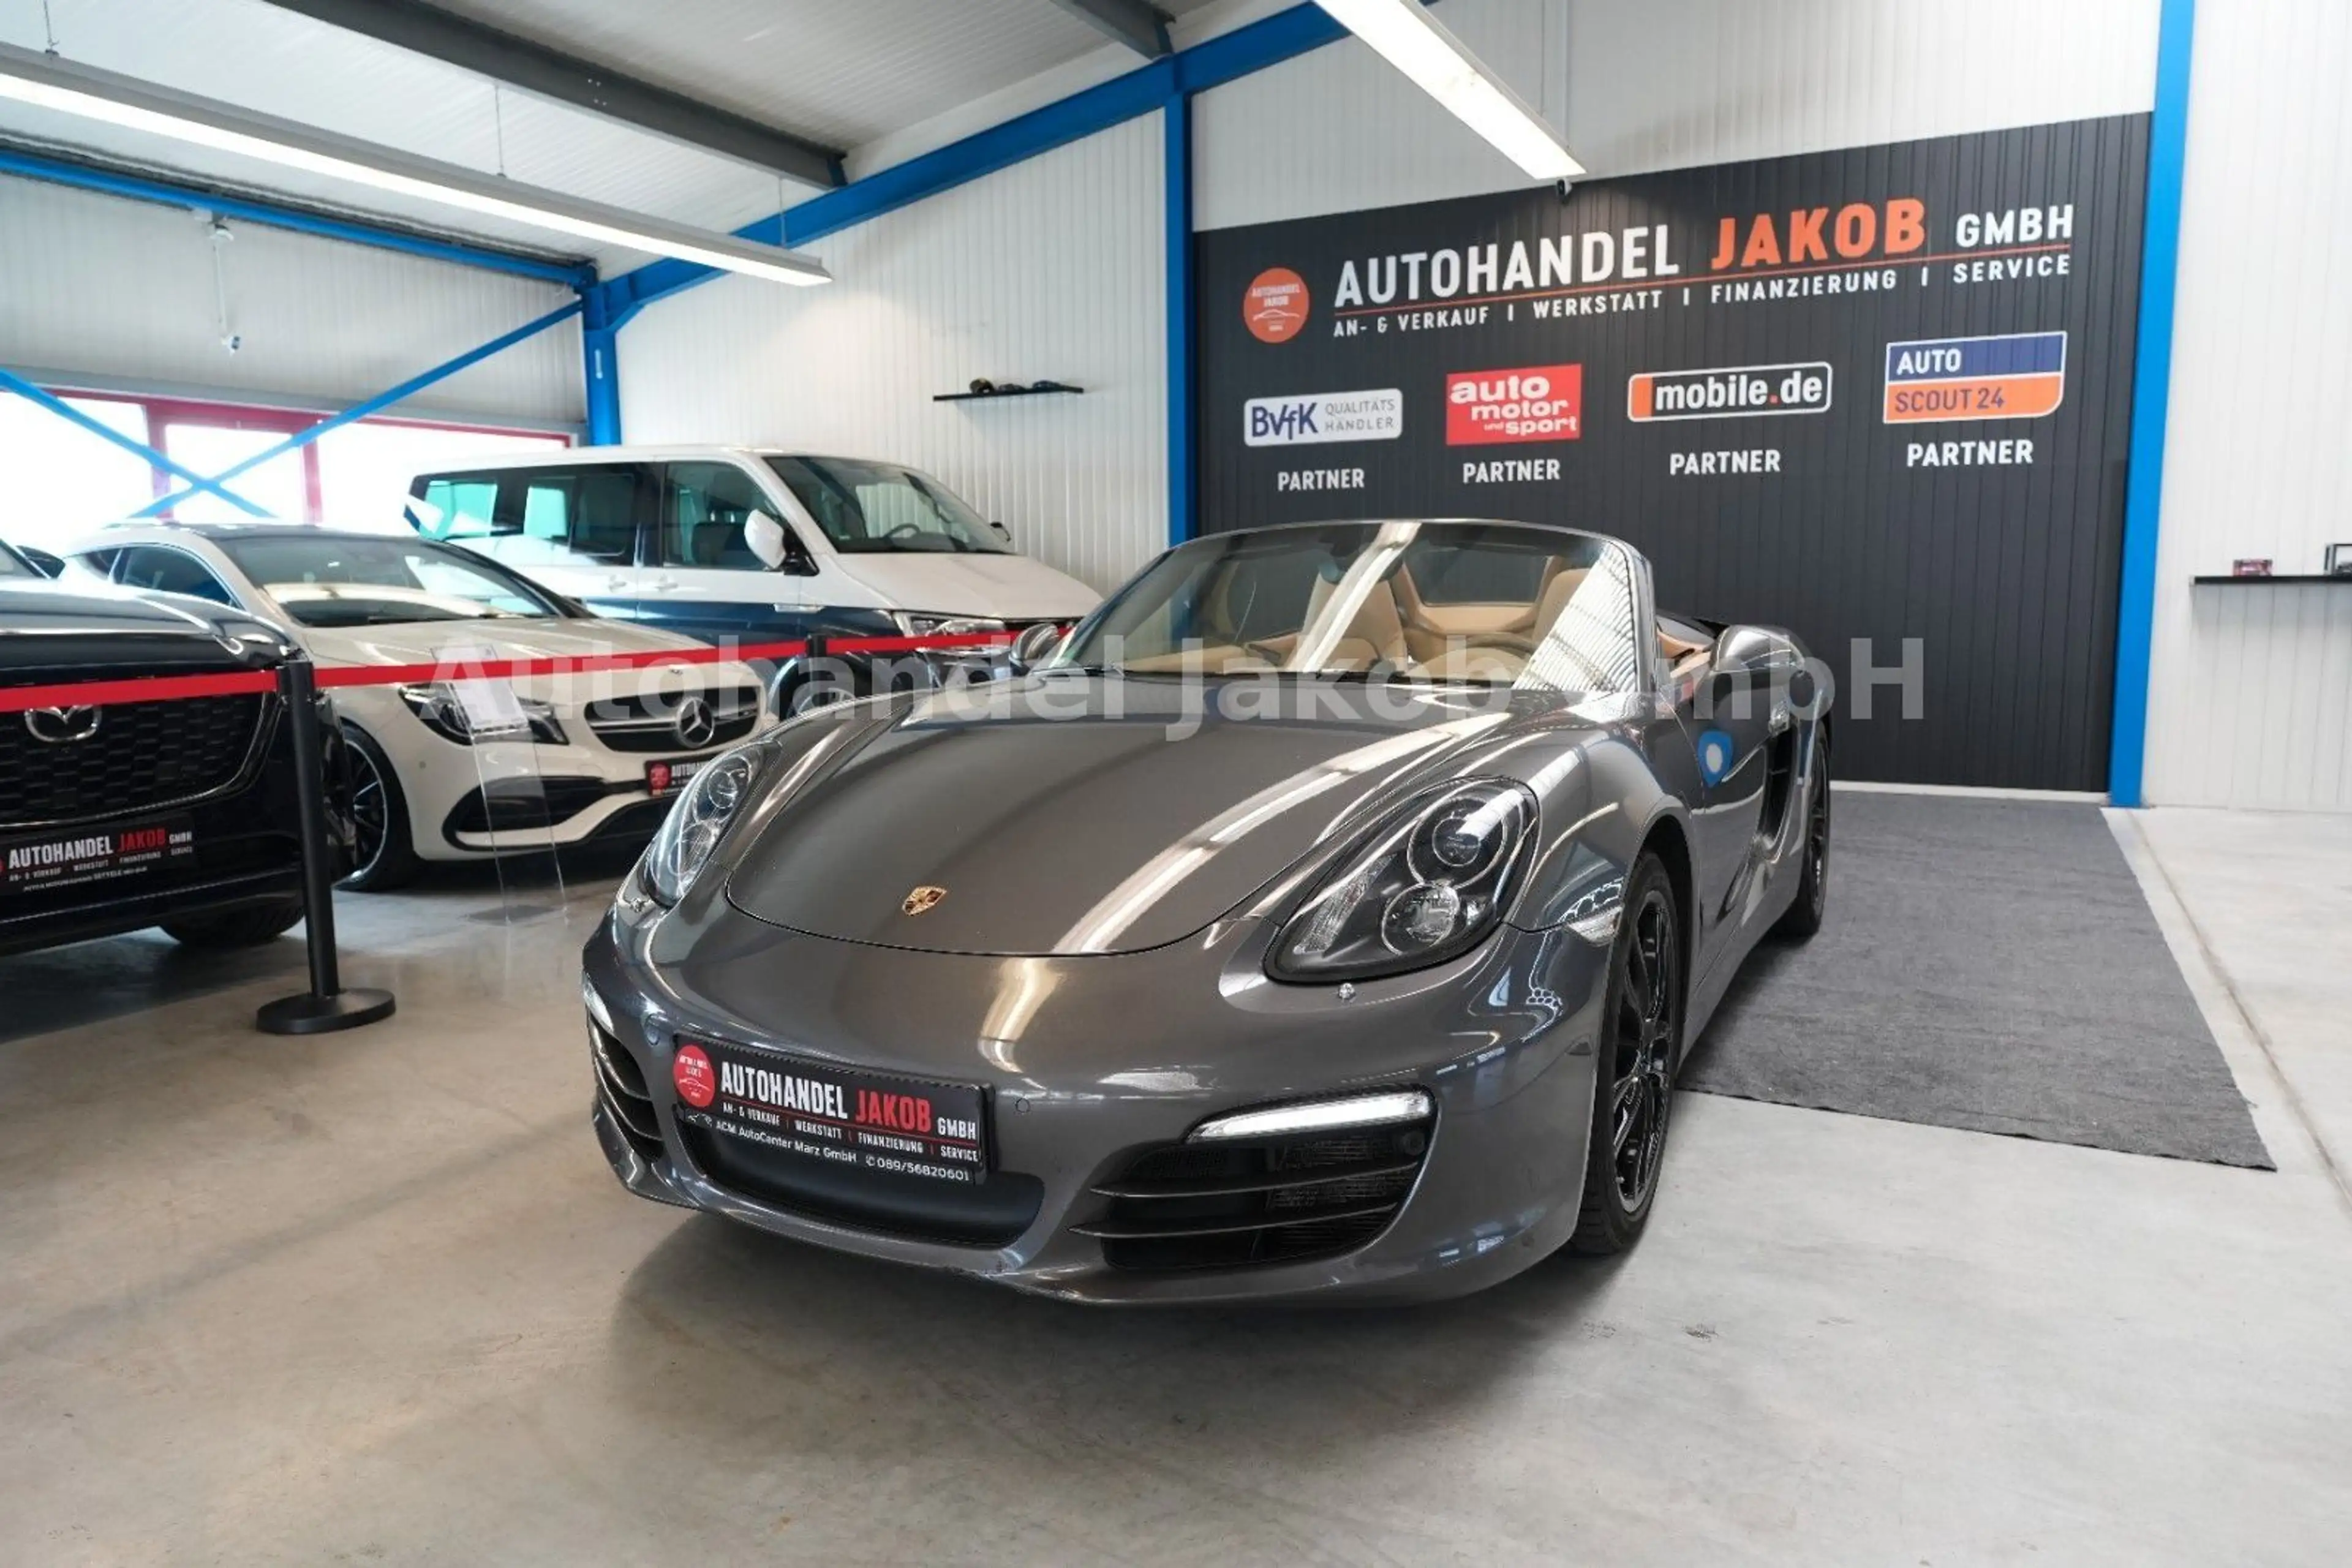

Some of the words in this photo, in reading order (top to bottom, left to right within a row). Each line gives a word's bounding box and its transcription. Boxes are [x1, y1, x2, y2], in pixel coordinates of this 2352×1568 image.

[1334, 224, 1679, 307] AUTOHANDEL
[1711, 198, 1926, 270] JAKOB
[1956, 204, 2074, 247] GMBH
[1333, 319, 1367, 337] AN-
[1377, 319, 1389, 334] &
[1398, 306, 1490, 331] VERKAUF
[1533, 290, 1663, 320] WERKSTATT
[1711, 269, 1897, 303] FINANZIERUNG
[1953, 254, 2071, 284] SERVICE
[1896, 348, 1962, 375] AUTO
[1450, 375, 1550, 404] auto
[1656, 370, 1823, 412] mobile.de
[1471, 399, 1569, 421] motor
[1505, 416, 1577, 437] sport
[1669, 449, 1781, 476] PARTNER
[1906, 439, 2034, 468] PARTNER
[1277, 467, 1365, 492] PARTNER
[1462, 458, 1561, 484] PARTNER
[9, 835, 114, 869] AUTOHANDEL
[118, 827, 166, 853] JAKOB
[722, 1061, 848, 1120] AUTOHANDEL
[855, 1089, 932, 1133] JAKOB
[937, 1116, 976, 1140] GMBH
[794, 1120, 843, 1140] WERKSTATT
[858, 1132, 924, 1154] FINANZIERUNG
[940, 1144, 979, 1163] SERVICE
[794, 1140, 821, 1156] Marz
[823, 1147, 858, 1163] GmbH
[876, 1157, 970, 1182] 089/56820601
